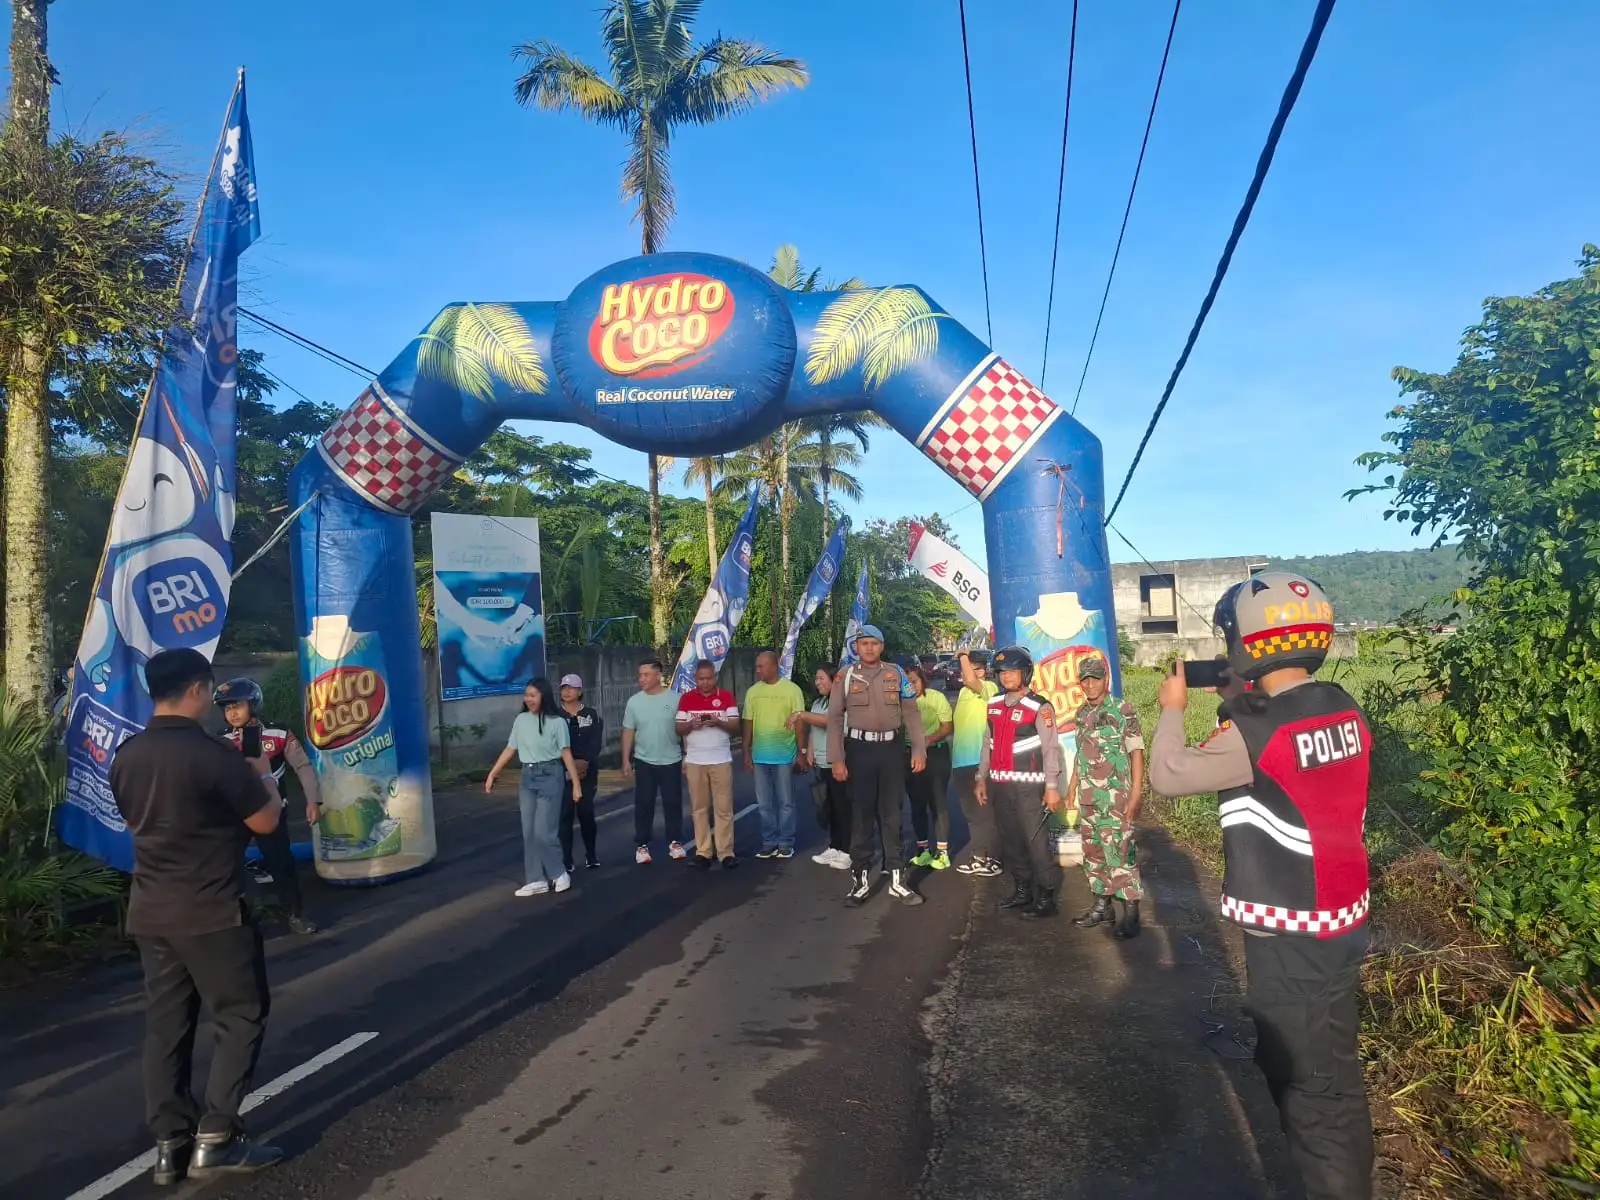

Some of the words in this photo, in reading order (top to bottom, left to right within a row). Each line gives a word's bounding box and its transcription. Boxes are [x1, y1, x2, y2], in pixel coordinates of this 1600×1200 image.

[602, 277, 726, 323] Hydro
[601, 313, 708, 373] Coco
[597, 388, 626, 402] Real
[628, 387, 689, 400] Coconut
[691, 387, 736, 400] Water
[147, 571, 210, 614] BRI
[952, 570, 980, 602] BSG
[173, 602, 216, 633] mo
[705, 634, 723, 649] BRI
[305, 670, 376, 710] Hydro
[82, 715, 114, 750] BRI
[310, 700, 369, 745] Coco
[343, 726, 394, 766] original
[1296, 720, 1362, 767] POLISI
